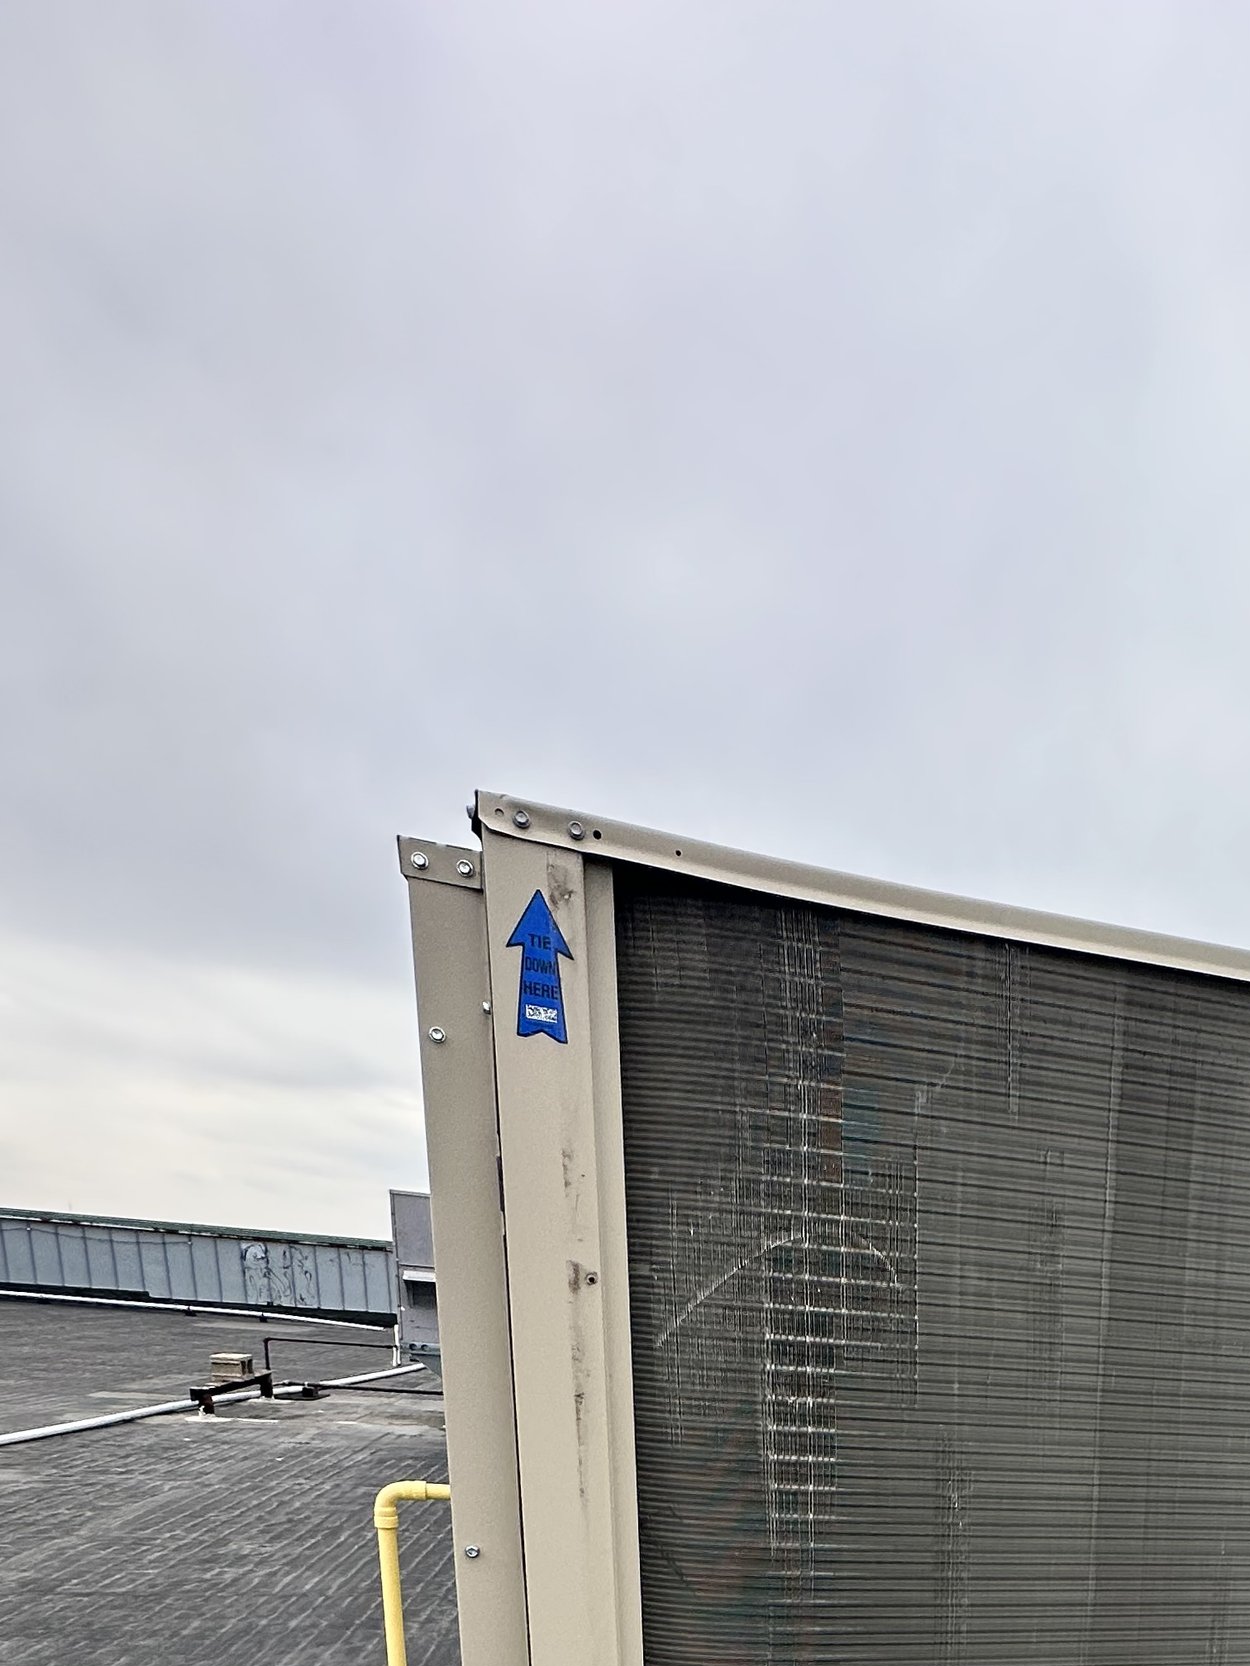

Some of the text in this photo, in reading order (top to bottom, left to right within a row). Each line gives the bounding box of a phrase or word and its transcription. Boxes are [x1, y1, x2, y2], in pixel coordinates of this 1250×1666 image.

[529, 934, 551, 950] TIE
[525, 957, 556, 975] DOWN
[523, 981, 558, 1000] HERE
